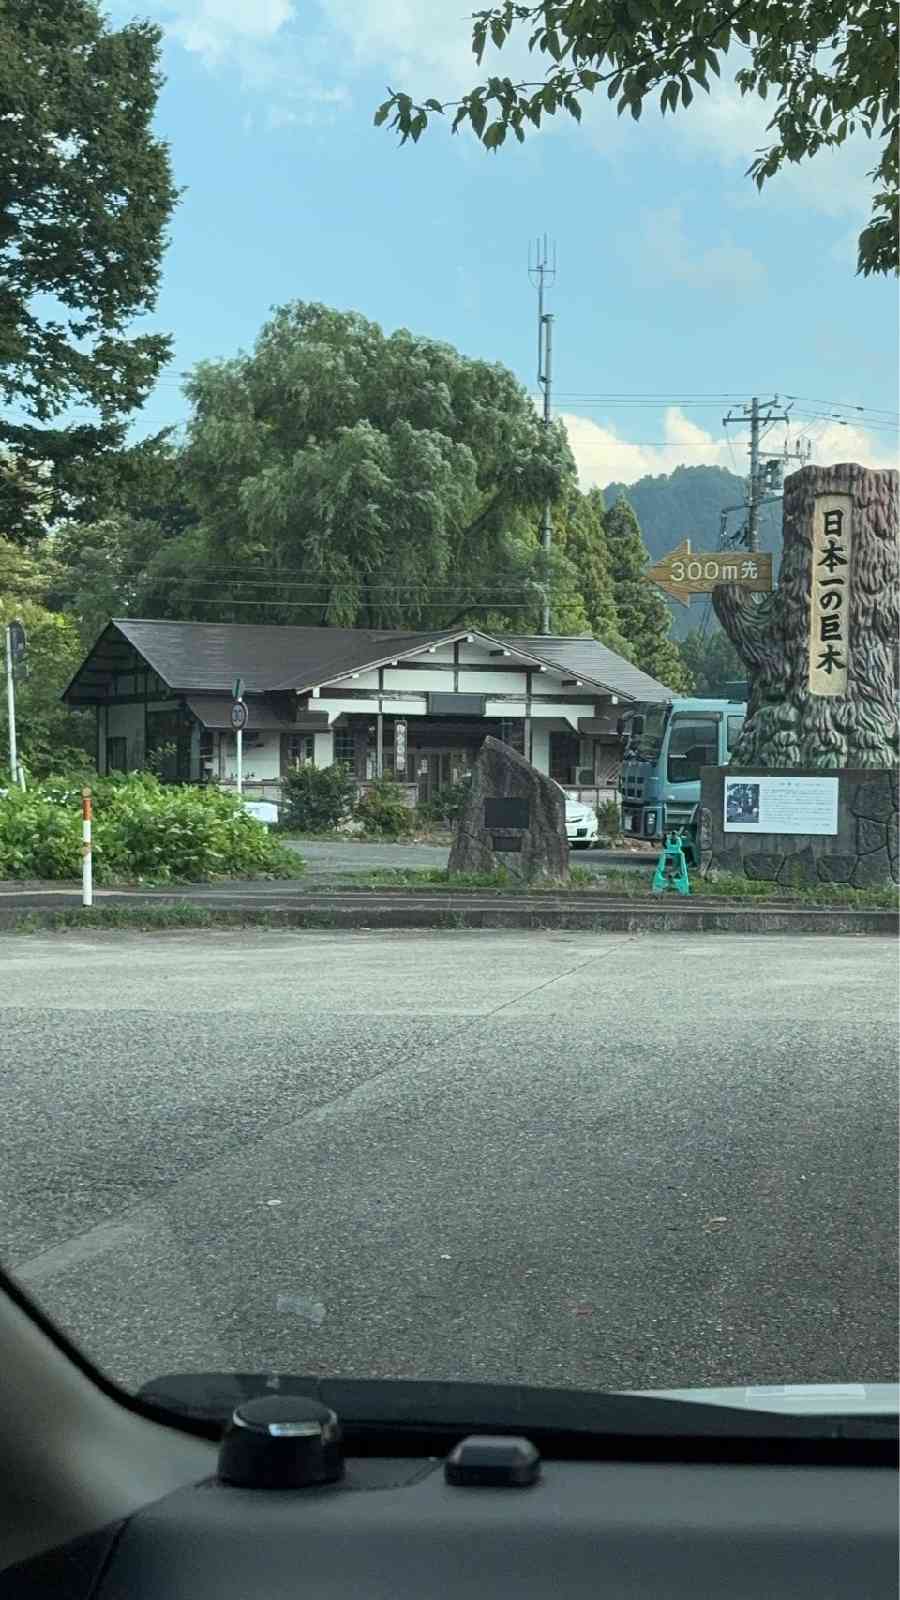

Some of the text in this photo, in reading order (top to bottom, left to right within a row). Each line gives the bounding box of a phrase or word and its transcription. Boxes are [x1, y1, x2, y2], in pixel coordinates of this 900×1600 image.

[670, 560, 759, 582] 300m先
[817, 509, 848, 674] 日本一の巨木
